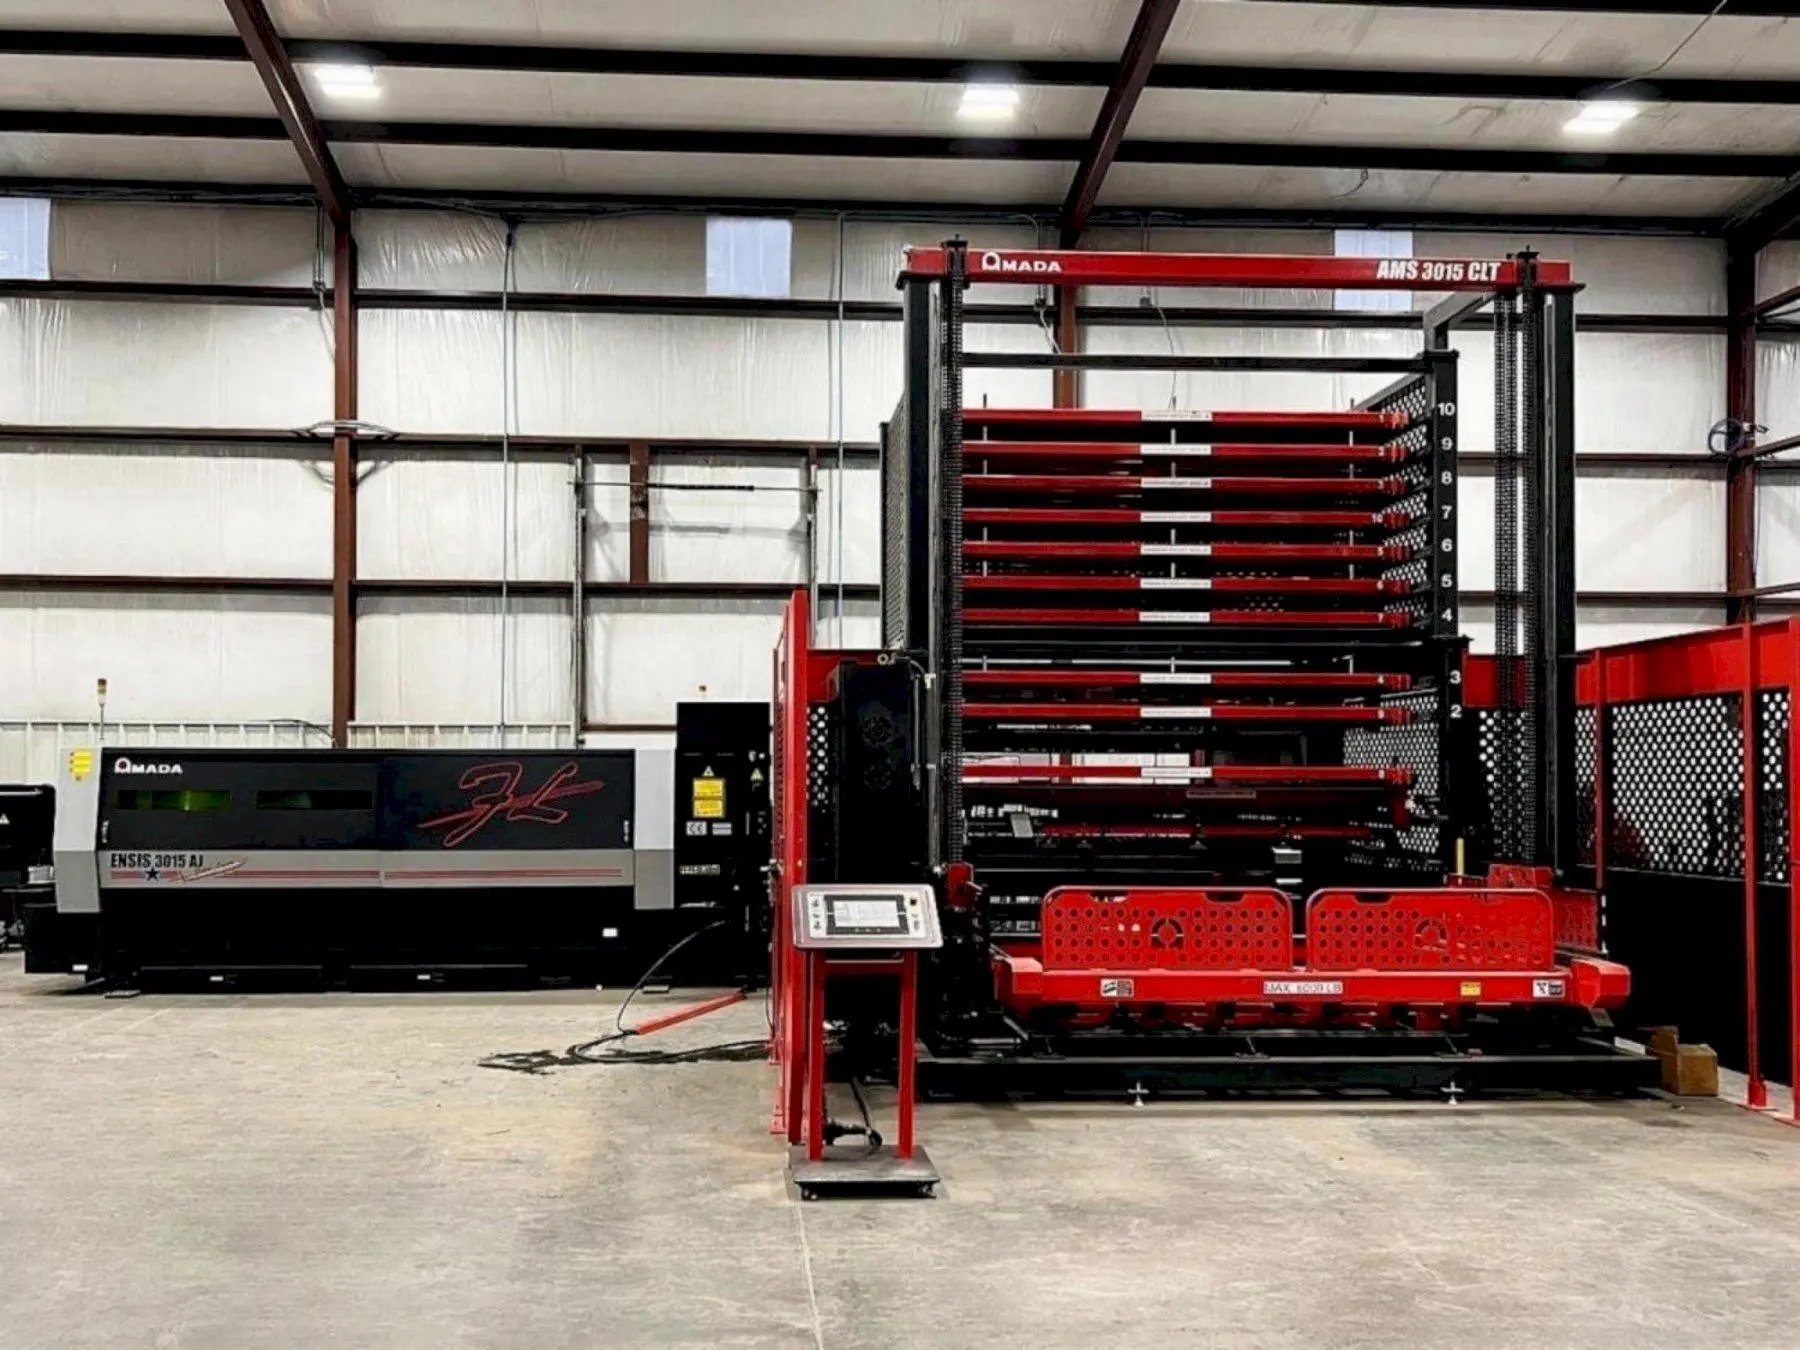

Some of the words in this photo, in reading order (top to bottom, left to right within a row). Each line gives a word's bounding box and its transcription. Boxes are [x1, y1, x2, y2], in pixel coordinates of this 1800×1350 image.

[982, 251, 1062, 272] AMADA
[1376, 260, 1419, 280] AMS
[1421, 261, 1464, 281] 3015
[1467, 261, 1501, 281] CLT
[1438, 402, 1455, 416] 10
[1441, 436, 1453, 451] 9
[1441, 471, 1453, 485] 8
[1441, 505, 1452, 519] 7
[1441, 538, 1453, 552] 6
[1441, 574, 1453, 588] 5
[1441, 607, 1453, 622] 4
[1450, 670, 1461, 684] 3
[1450, 704, 1462, 718] 2
[114, 756, 183, 774] AMADA
[110, 853, 152, 868] ENSIS
[155, 854, 186, 868] 3015
